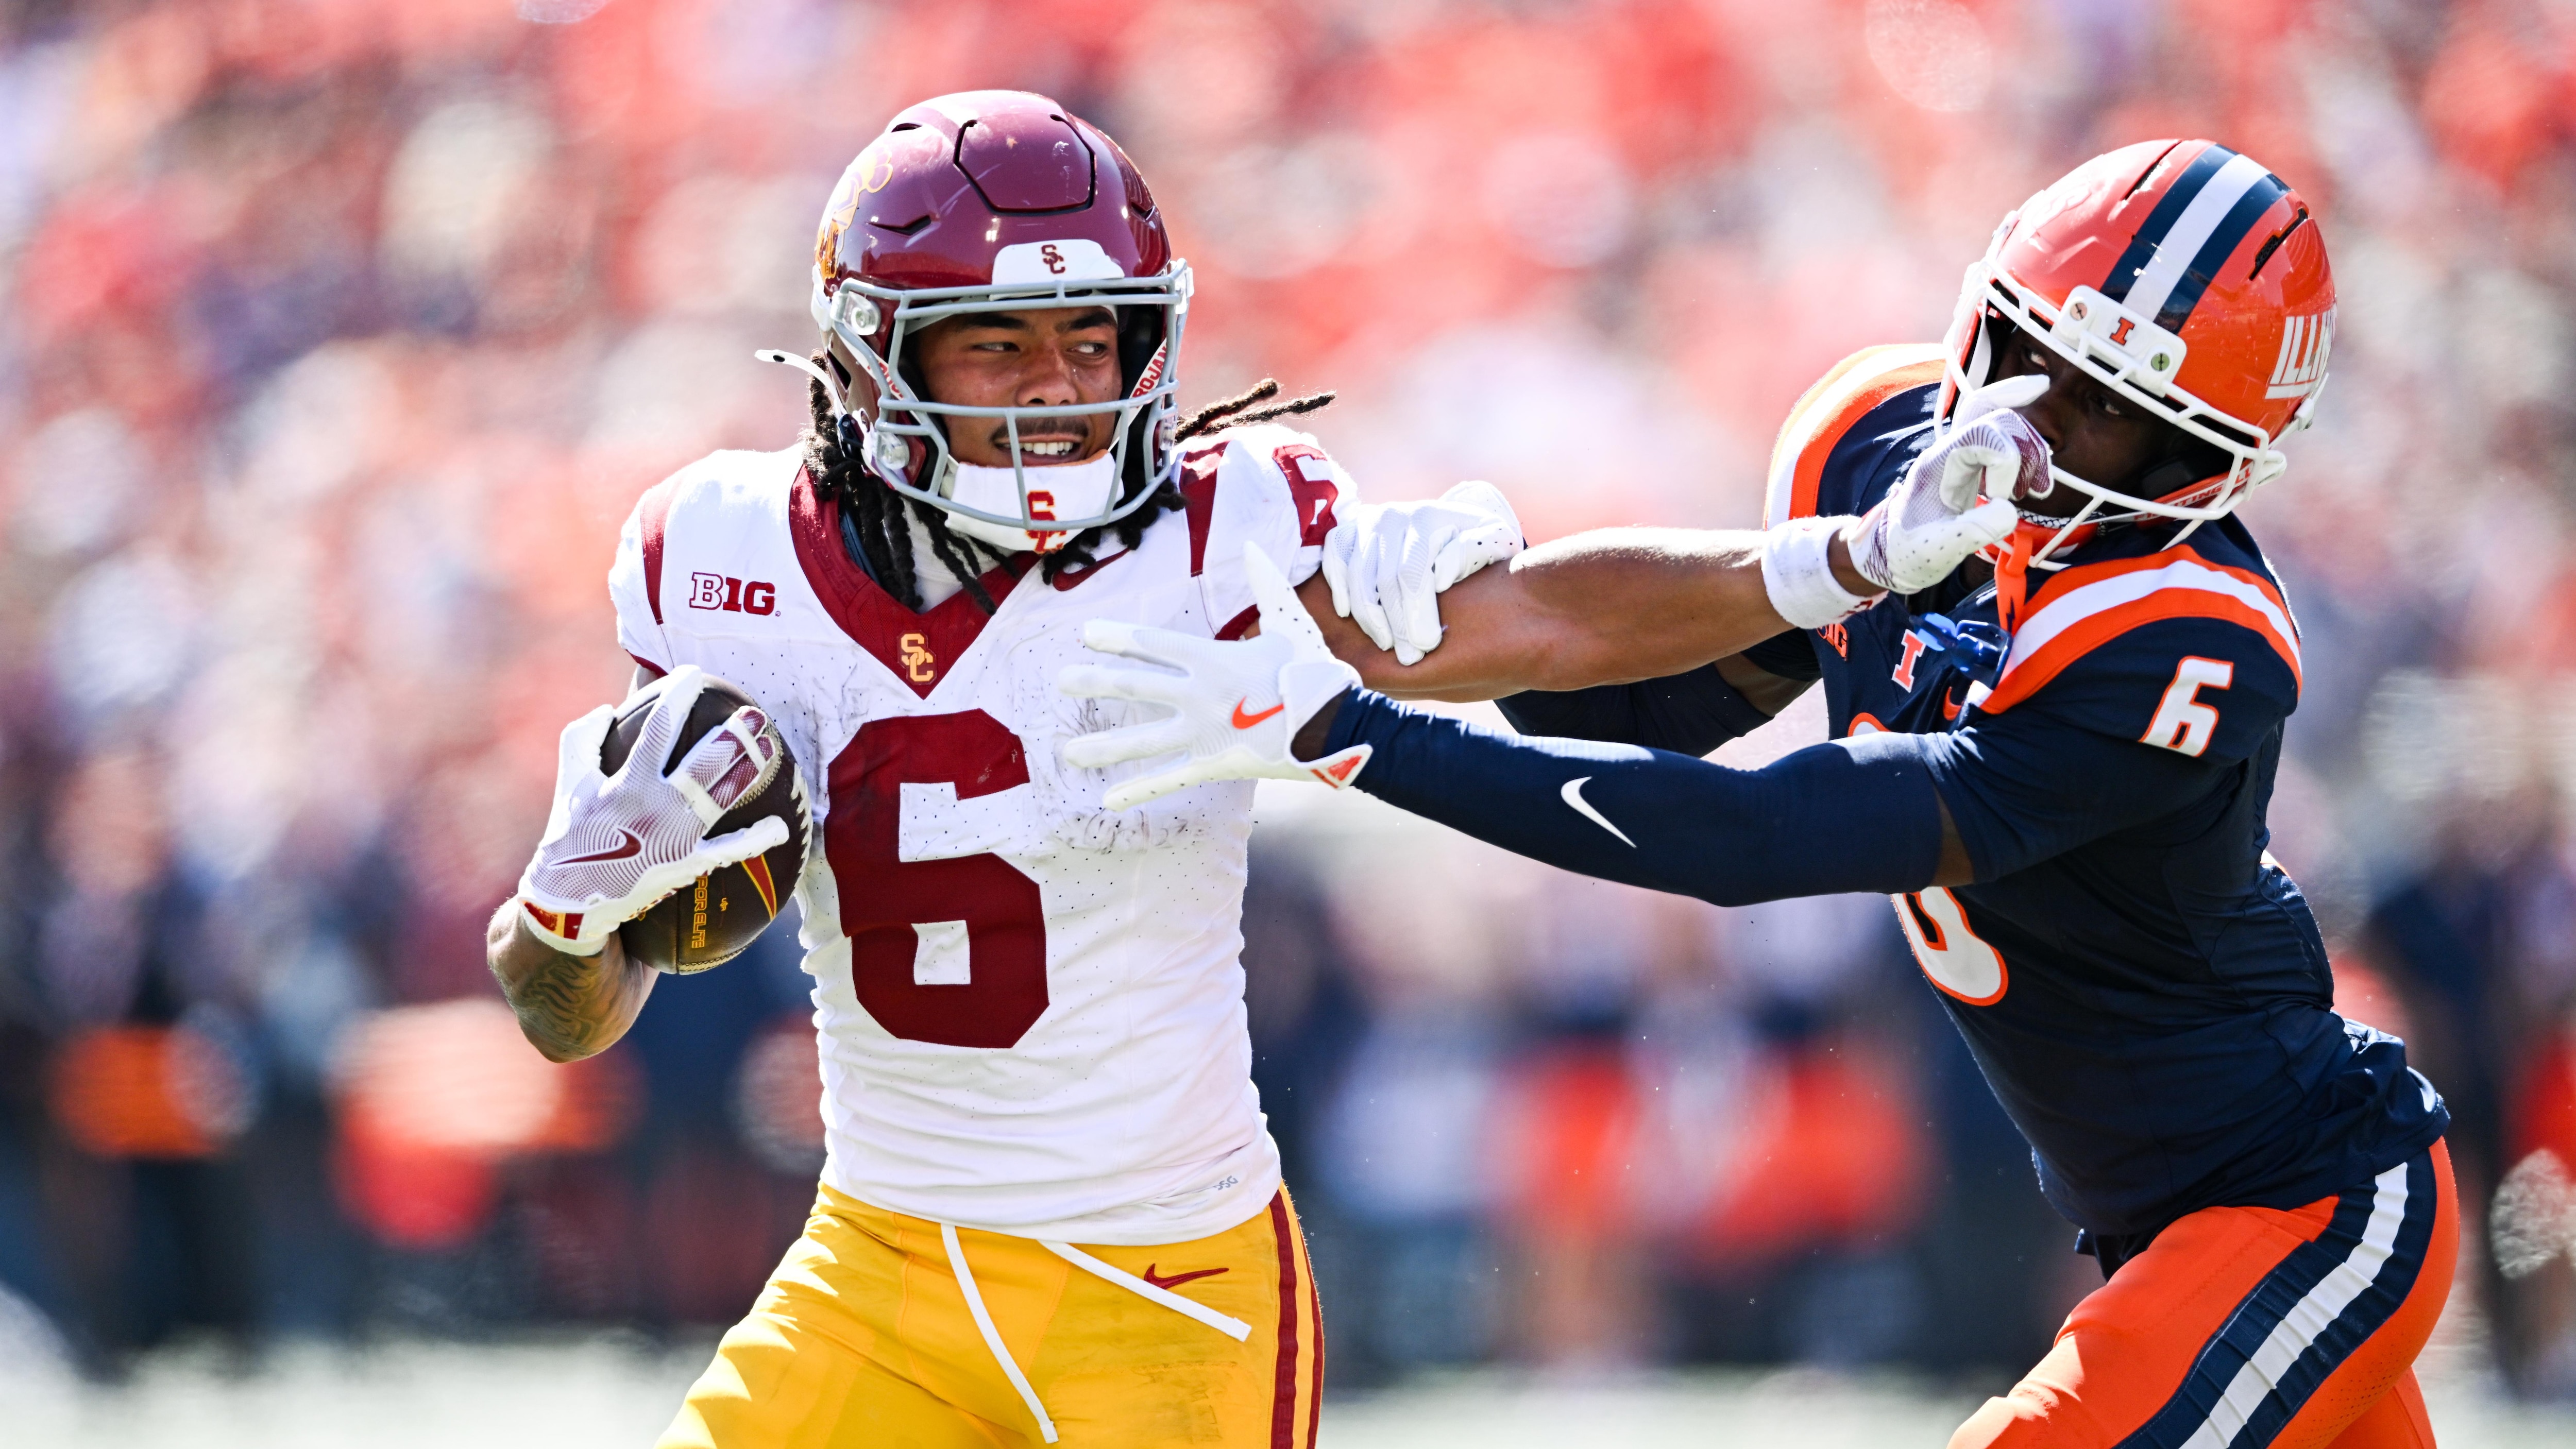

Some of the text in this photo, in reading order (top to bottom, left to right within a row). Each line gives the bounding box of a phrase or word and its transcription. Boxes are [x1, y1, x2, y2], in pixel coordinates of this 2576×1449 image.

[1041, 244, 1065, 274] SC
[2109, 316, 2136, 346] I
[1271, 444, 1339, 547] 6
[901, 633, 934, 682] SC
[1891, 628, 1926, 693] I
[2138, 655, 2234, 757] 6
[691, 875, 708, 948] POR ELITE
[823, 708, 1049, 1049] 6
